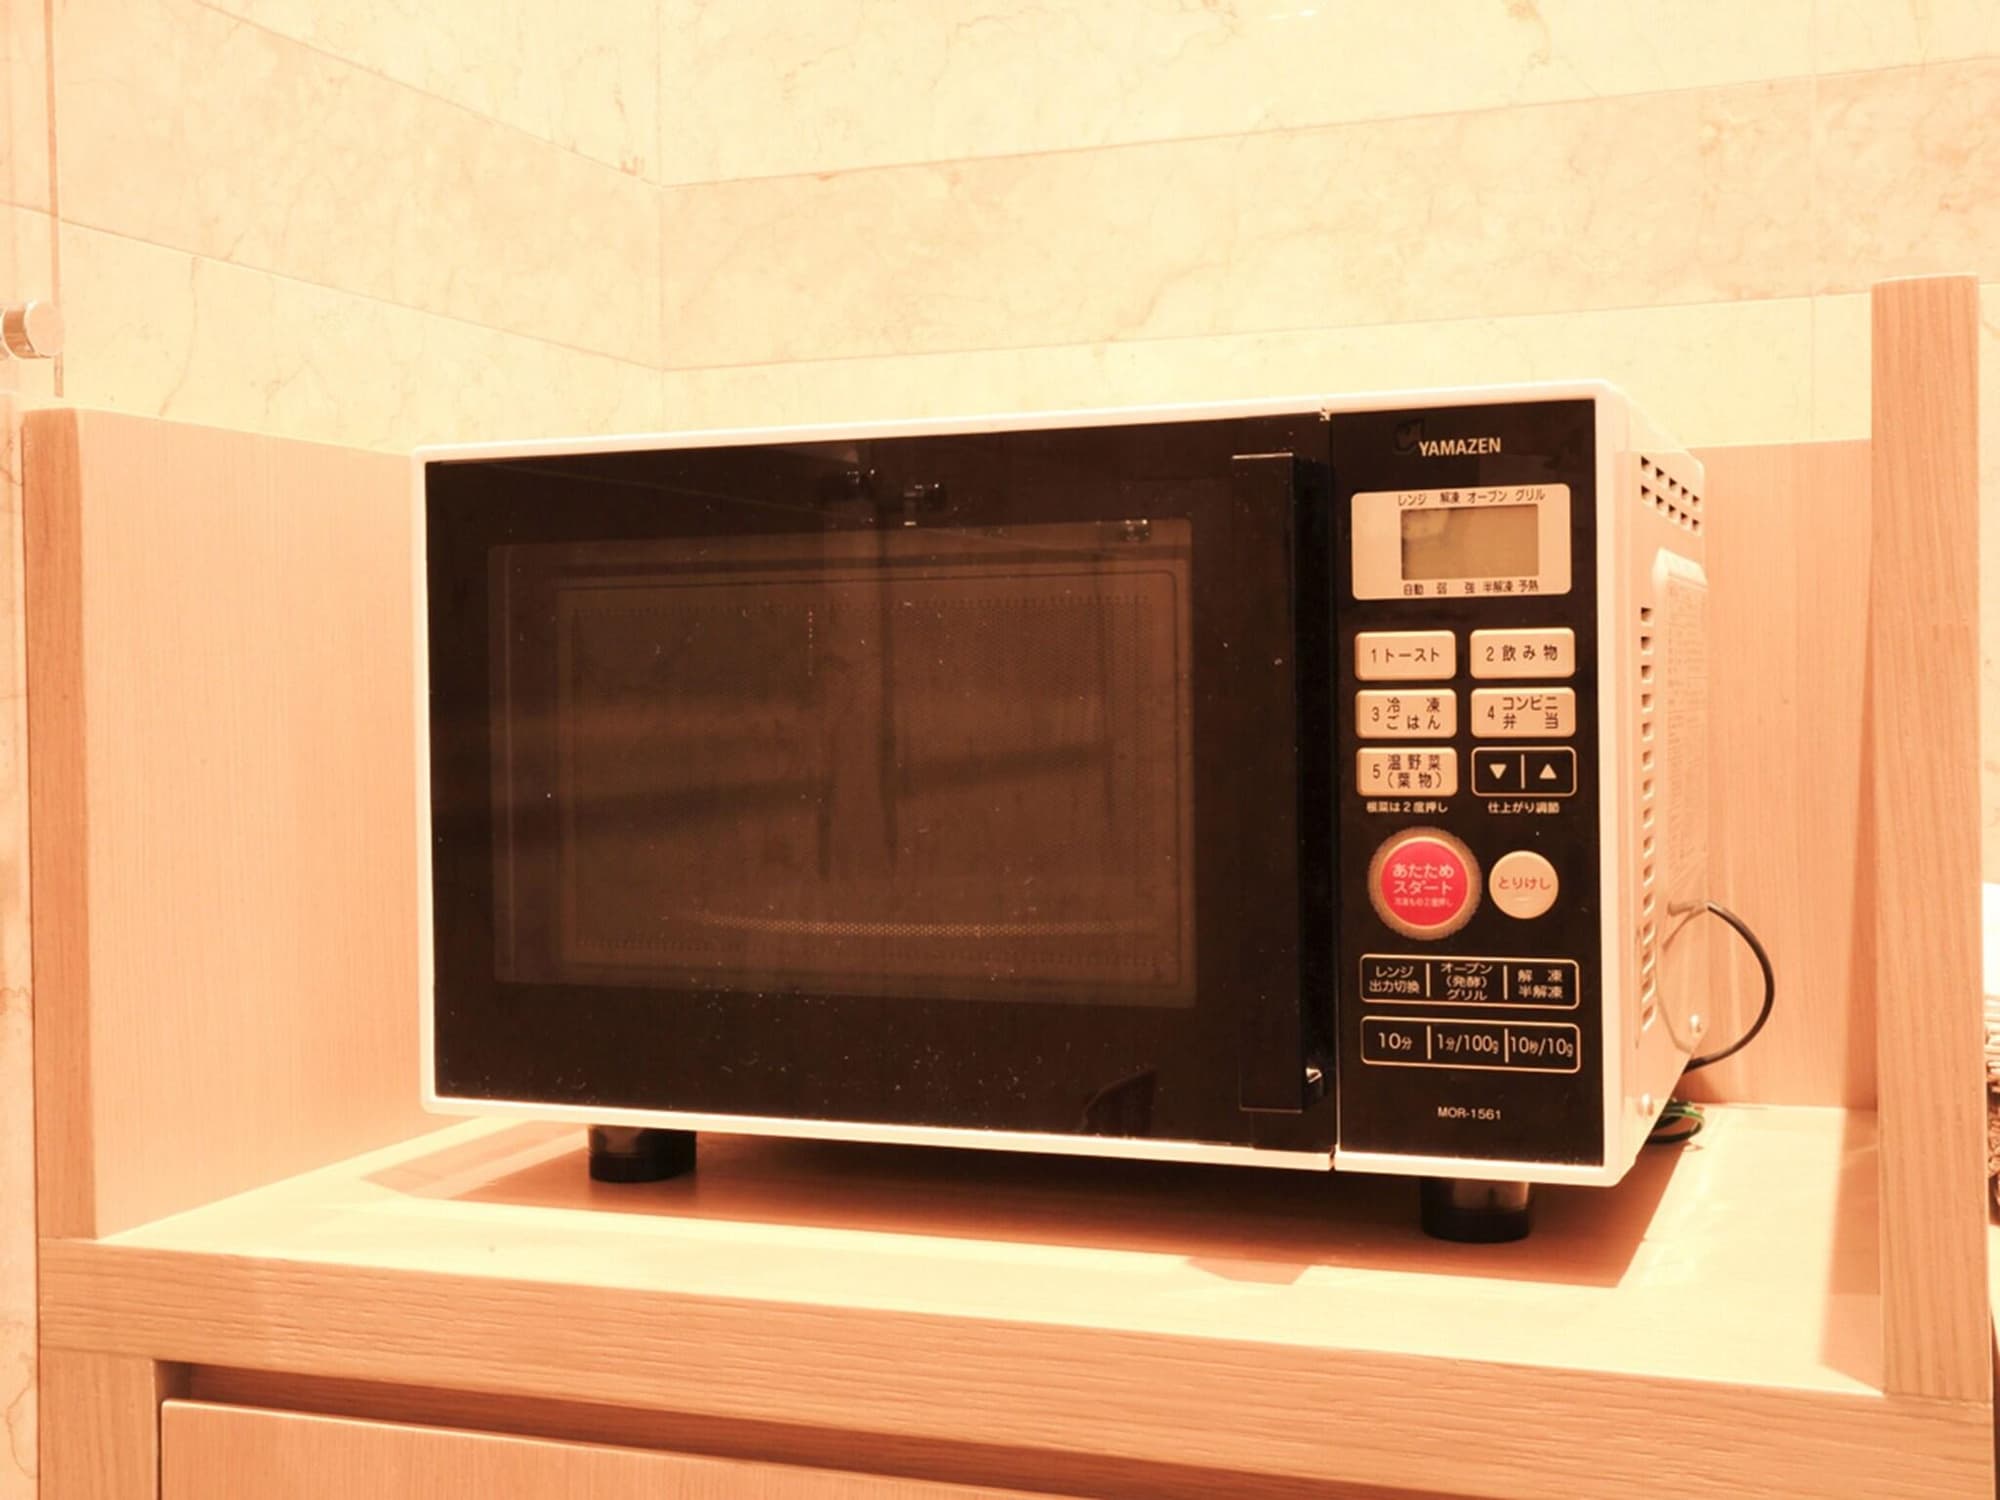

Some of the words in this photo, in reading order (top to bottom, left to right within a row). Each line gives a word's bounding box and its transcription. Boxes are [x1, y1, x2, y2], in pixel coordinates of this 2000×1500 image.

[1419, 437, 1501, 457] YAMAZEN
[1399, 494, 1427, 506] レンジ
[1440, 491, 1460, 503] 解凍
[1515, 487, 1545, 501] グリル
[1403, 583, 1424, 596] 自動
[1464, 581, 1476, 594] 強
[1483, 580, 1514, 593] 半解凍
[1519, 579, 1540, 593] 予熱
[1502, 695, 1558, 711] コンビニ
[1372, 707, 1380, 722] 3
[1487, 706, 1495, 720] 4
[1386, 715, 1441, 730] ごはん
[1387, 754, 1442, 771] 温野菜
[1372, 764, 1381, 779] 5
[1392, 863, 1455, 879] あたため
[1498, 876, 1551, 890] とりけし
[1375, 965, 1414, 978] レンジ
[1446, 988, 1487, 1001] グリル
[1518, 985, 1563, 999] 半解凍
[1378, 1032, 1412, 1050] 10分
[1437, 1106, 1502, 1121] MOR-1561
